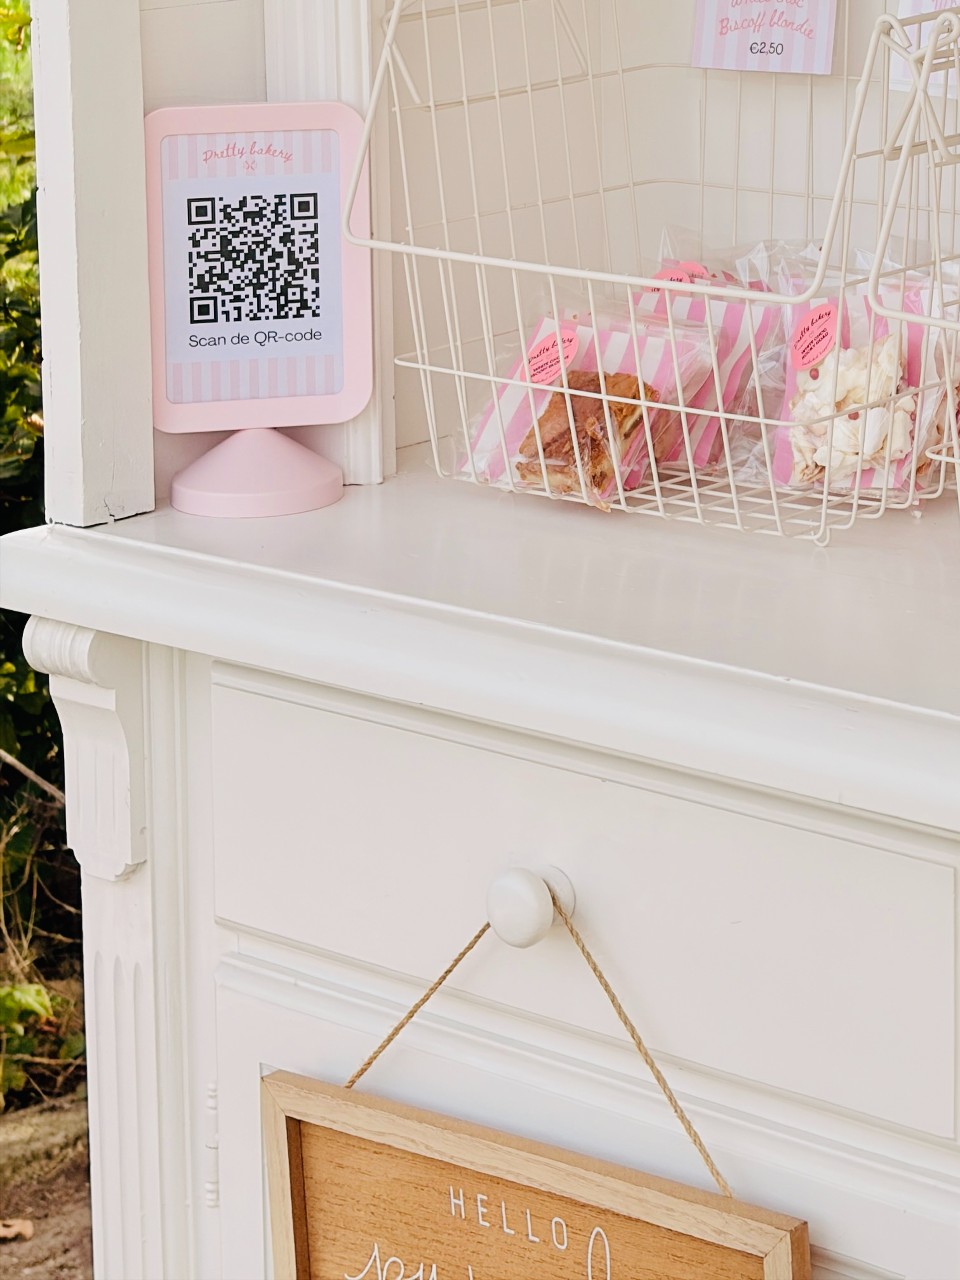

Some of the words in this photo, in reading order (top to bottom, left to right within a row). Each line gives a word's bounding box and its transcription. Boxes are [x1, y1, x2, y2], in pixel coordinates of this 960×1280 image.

[719, 11, 767, 36] Biscoff
[769, 9, 815, 39] blondie
[749, 41, 784, 56] €2,50
[203, 142, 245, 164] Pretty
[250, 141, 293, 163] bakery
[188, 334, 227, 348] Scan
[230, 332, 250, 346] de
[253, 328, 322, 347] QR-code
[450, 1185, 568, 1250] HELLO
